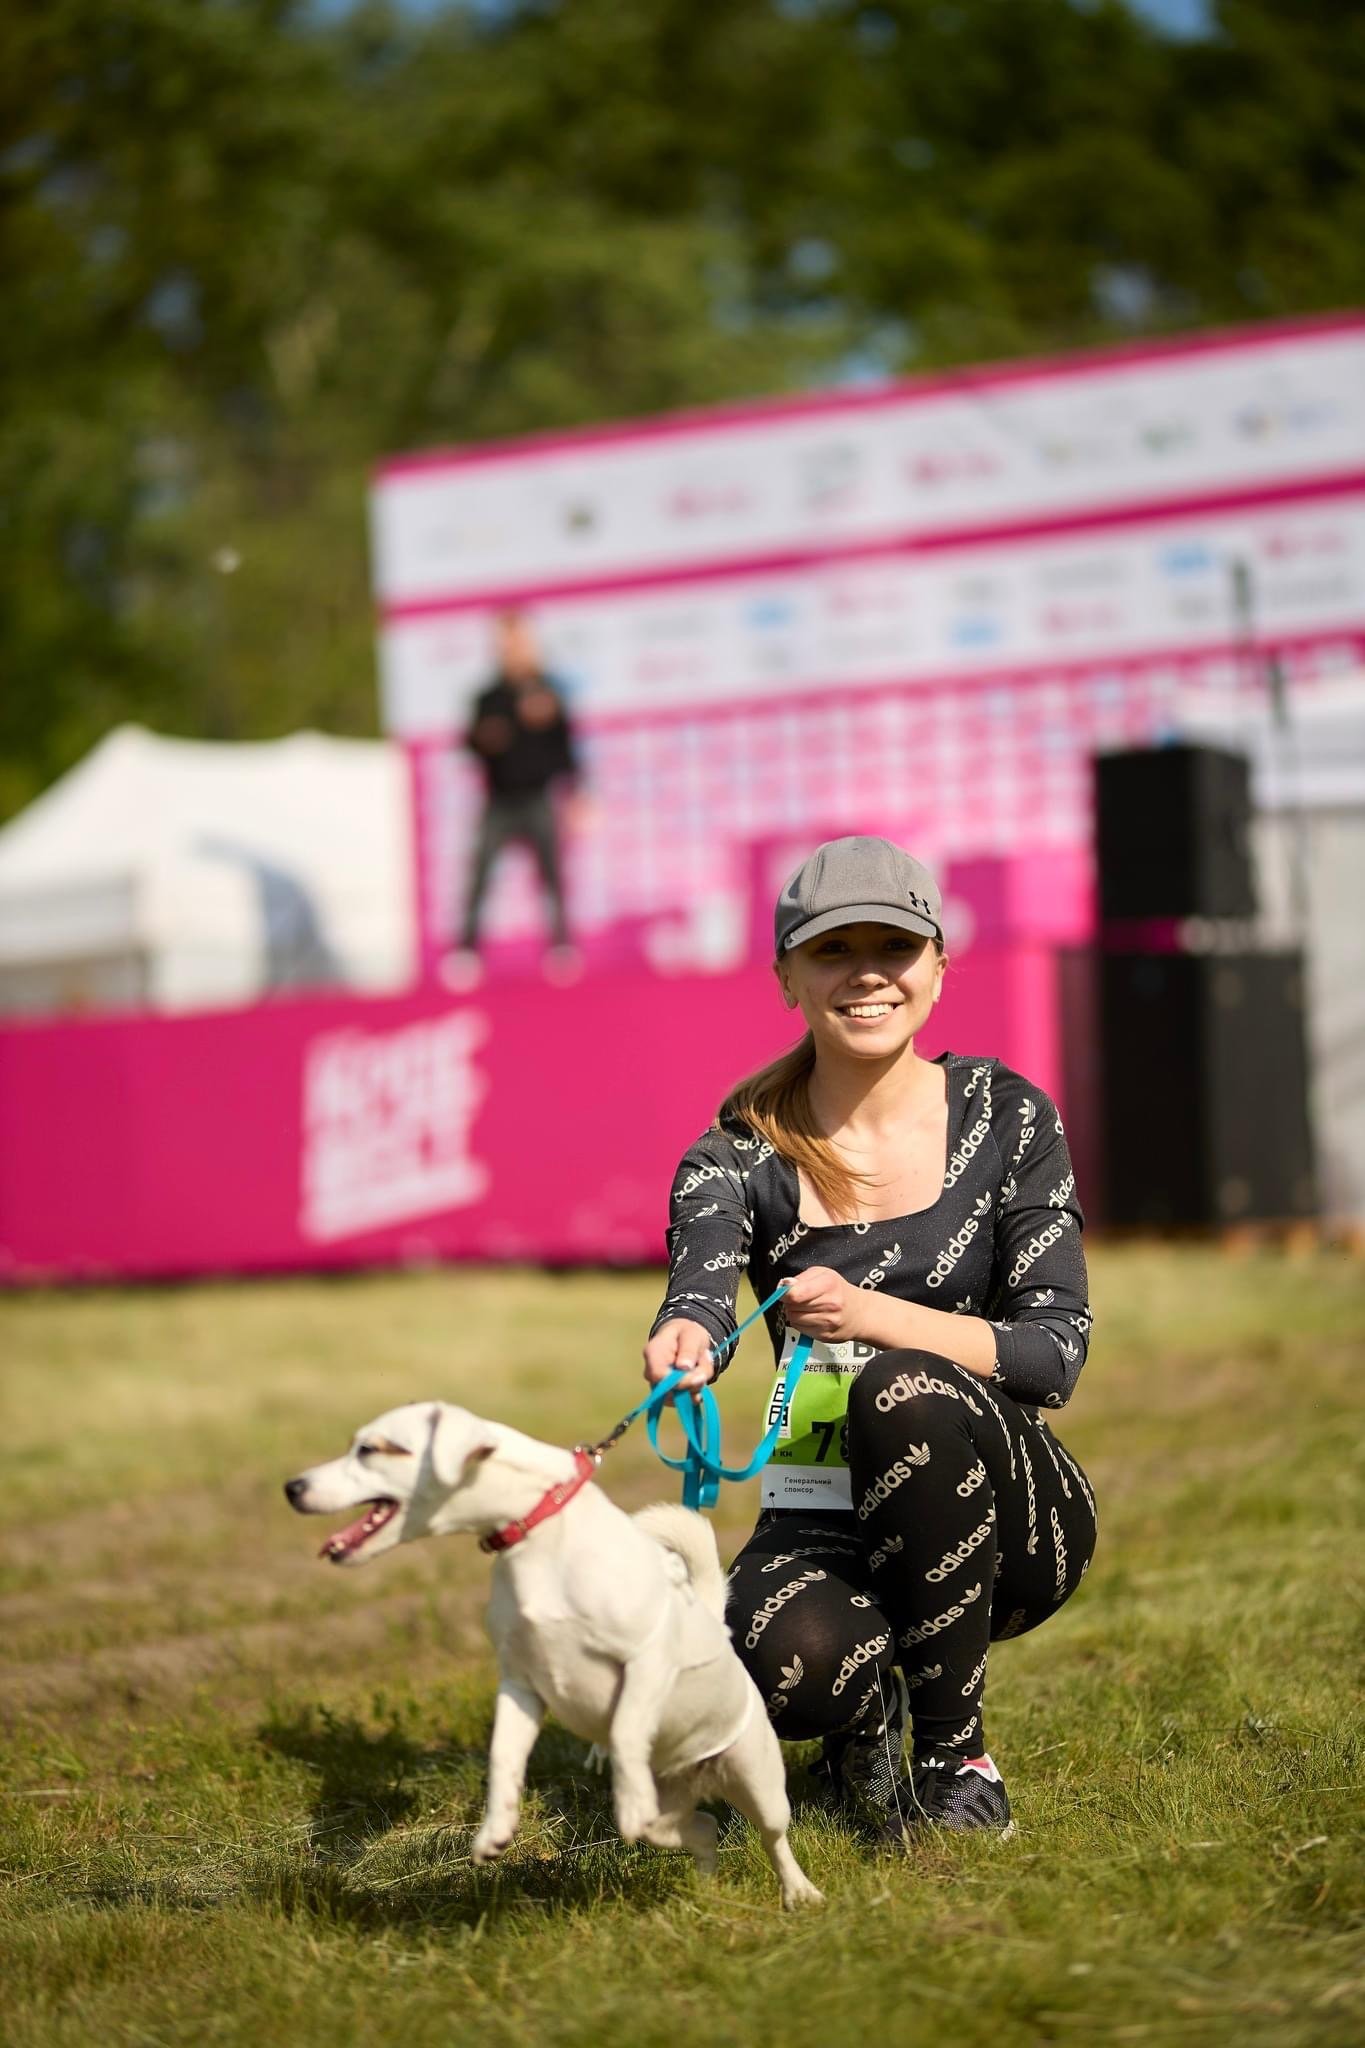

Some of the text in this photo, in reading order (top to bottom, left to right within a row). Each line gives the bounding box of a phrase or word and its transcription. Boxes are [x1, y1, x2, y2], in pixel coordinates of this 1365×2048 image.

[943, 1119, 991, 1188] adidas
[768, 1221, 810, 1266] adida
[926, 1217, 979, 1289] adidas
[1008, 1222, 1063, 1288] adidas
[875, 1371, 960, 1413] adidas
[784, 1486, 814, 1494] спонсор
[858, 1461, 912, 1521] adidas
[956, 1458, 987, 1498] adid
[1020, 1434, 1037, 1528] adidas
[925, 1523, 992, 1583] adidas
[1050, 1506, 1067, 1586] adidas
[745, 1580, 808, 1650] adidas
[900, 1605, 965, 1650] adidas
[831, 1635, 887, 1697] adidas
[961, 1653, 989, 1697] adid
